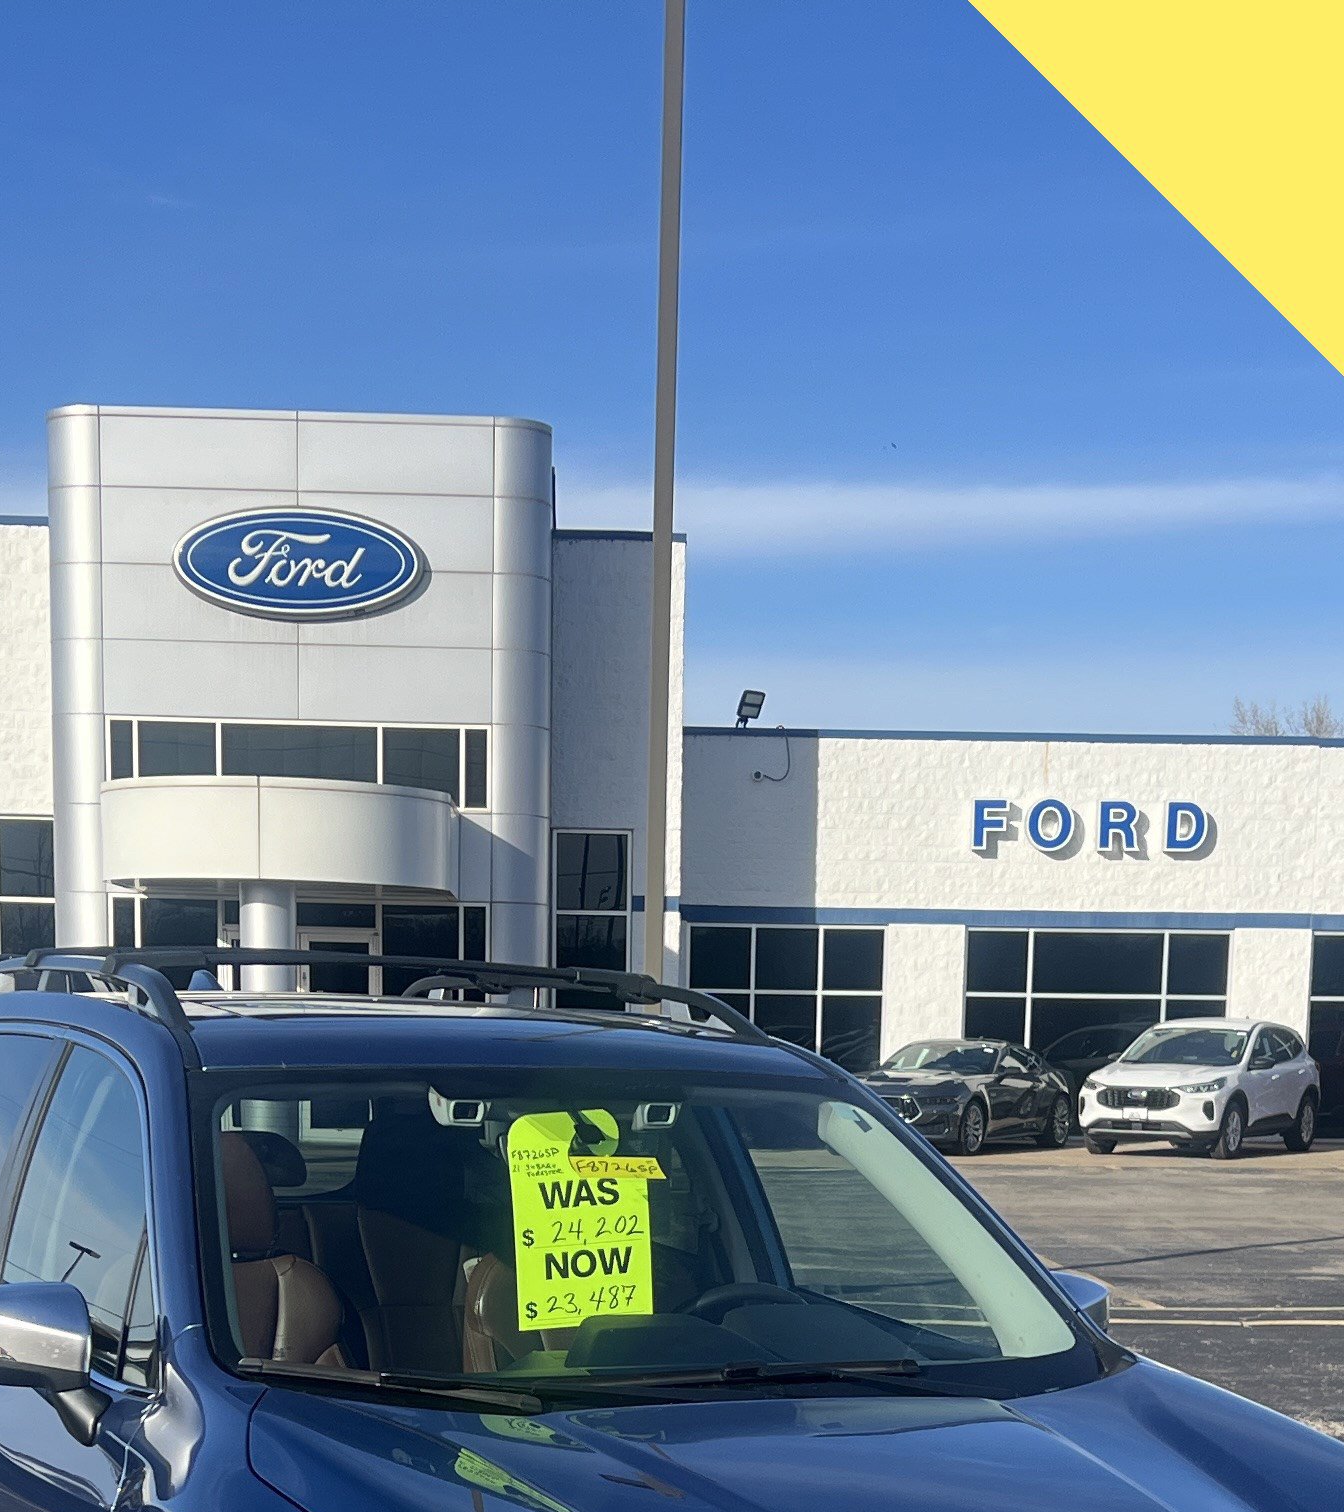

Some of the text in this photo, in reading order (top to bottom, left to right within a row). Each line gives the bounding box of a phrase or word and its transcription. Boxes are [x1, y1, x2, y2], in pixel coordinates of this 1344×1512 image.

[227, 529, 366, 589] Ford
[972, 798, 1208, 852] FORD
[538, 1178, 620, 1210] WAS
[522, 1215, 644, 1248] $ 24,202
[545, 1246, 632, 1280] NOW
[525, 1284, 637, 1321] $ 23,487
